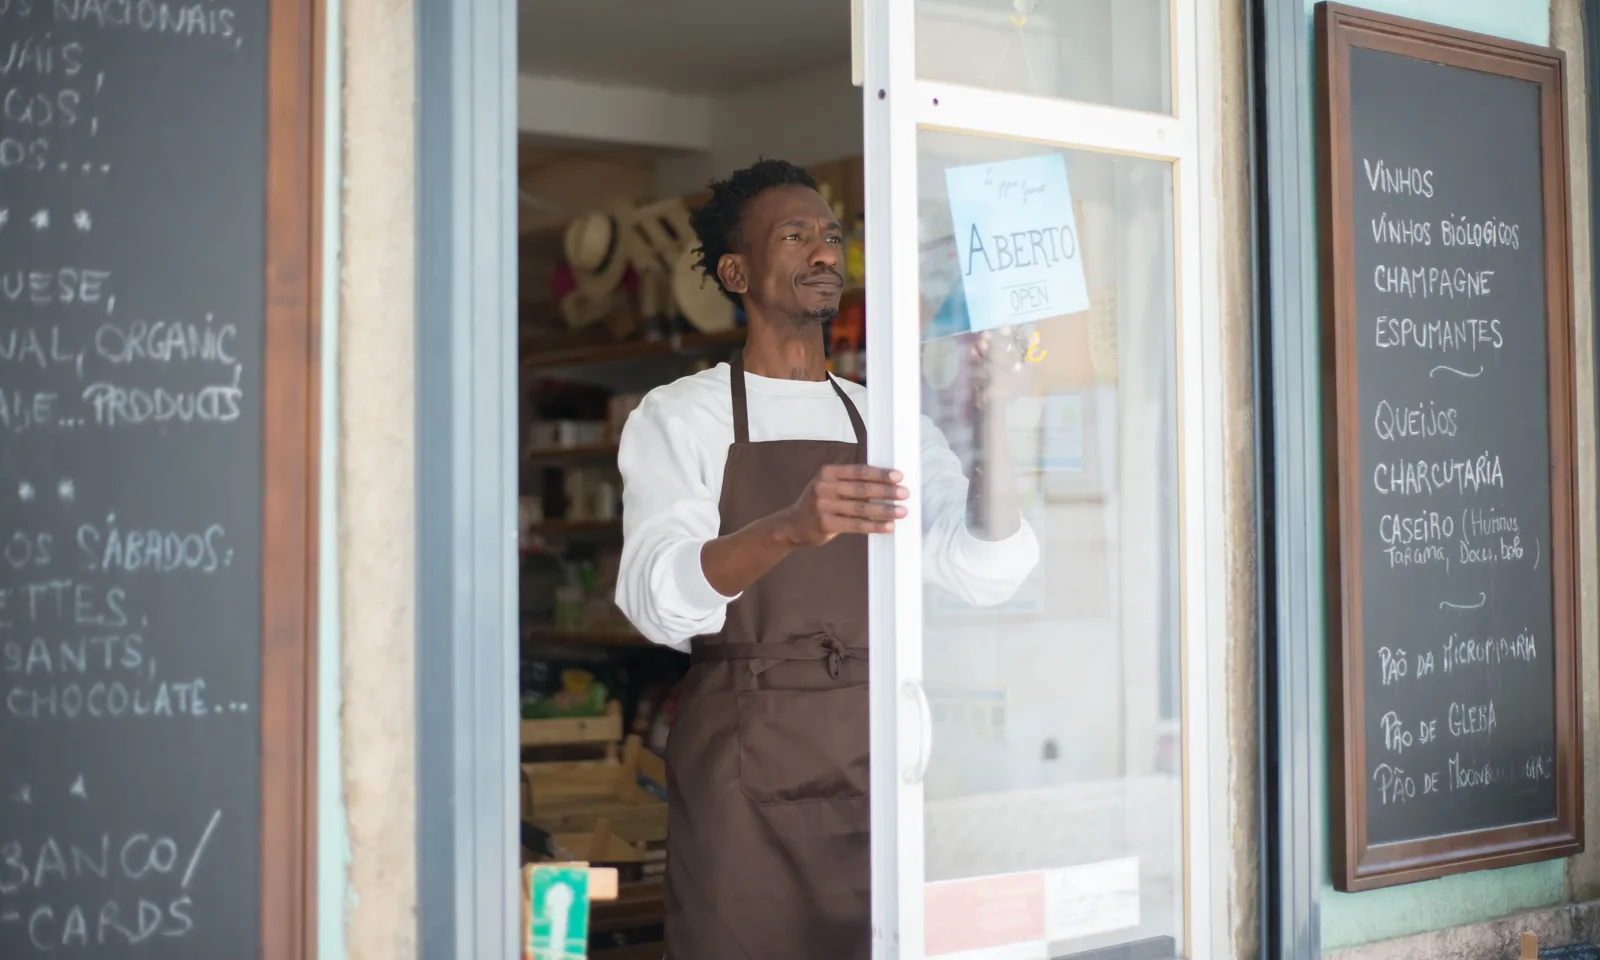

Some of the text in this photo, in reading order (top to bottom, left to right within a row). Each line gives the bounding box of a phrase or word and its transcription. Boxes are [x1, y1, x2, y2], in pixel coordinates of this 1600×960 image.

[966, 222, 1076, 276] ABERTO
[1009, 285, 1049, 311] OPEN
[1373, 264, 1495, 298] CHAMPAGNE
[1375, 315, 1503, 353] ESPUMANTES
[83, 382, 243, 427] PRODUCTS
[1373, 451, 1504, 495] CHARCUTARIA
[1379, 508, 1455, 545] CASEIRO
[6, 676, 250, 720] CHOCOLATE...
[1419, 718, 1438, 745] DE
[1447, 698, 1498, 740] GLEBA
[1423, 771, 1440, 796] DE
